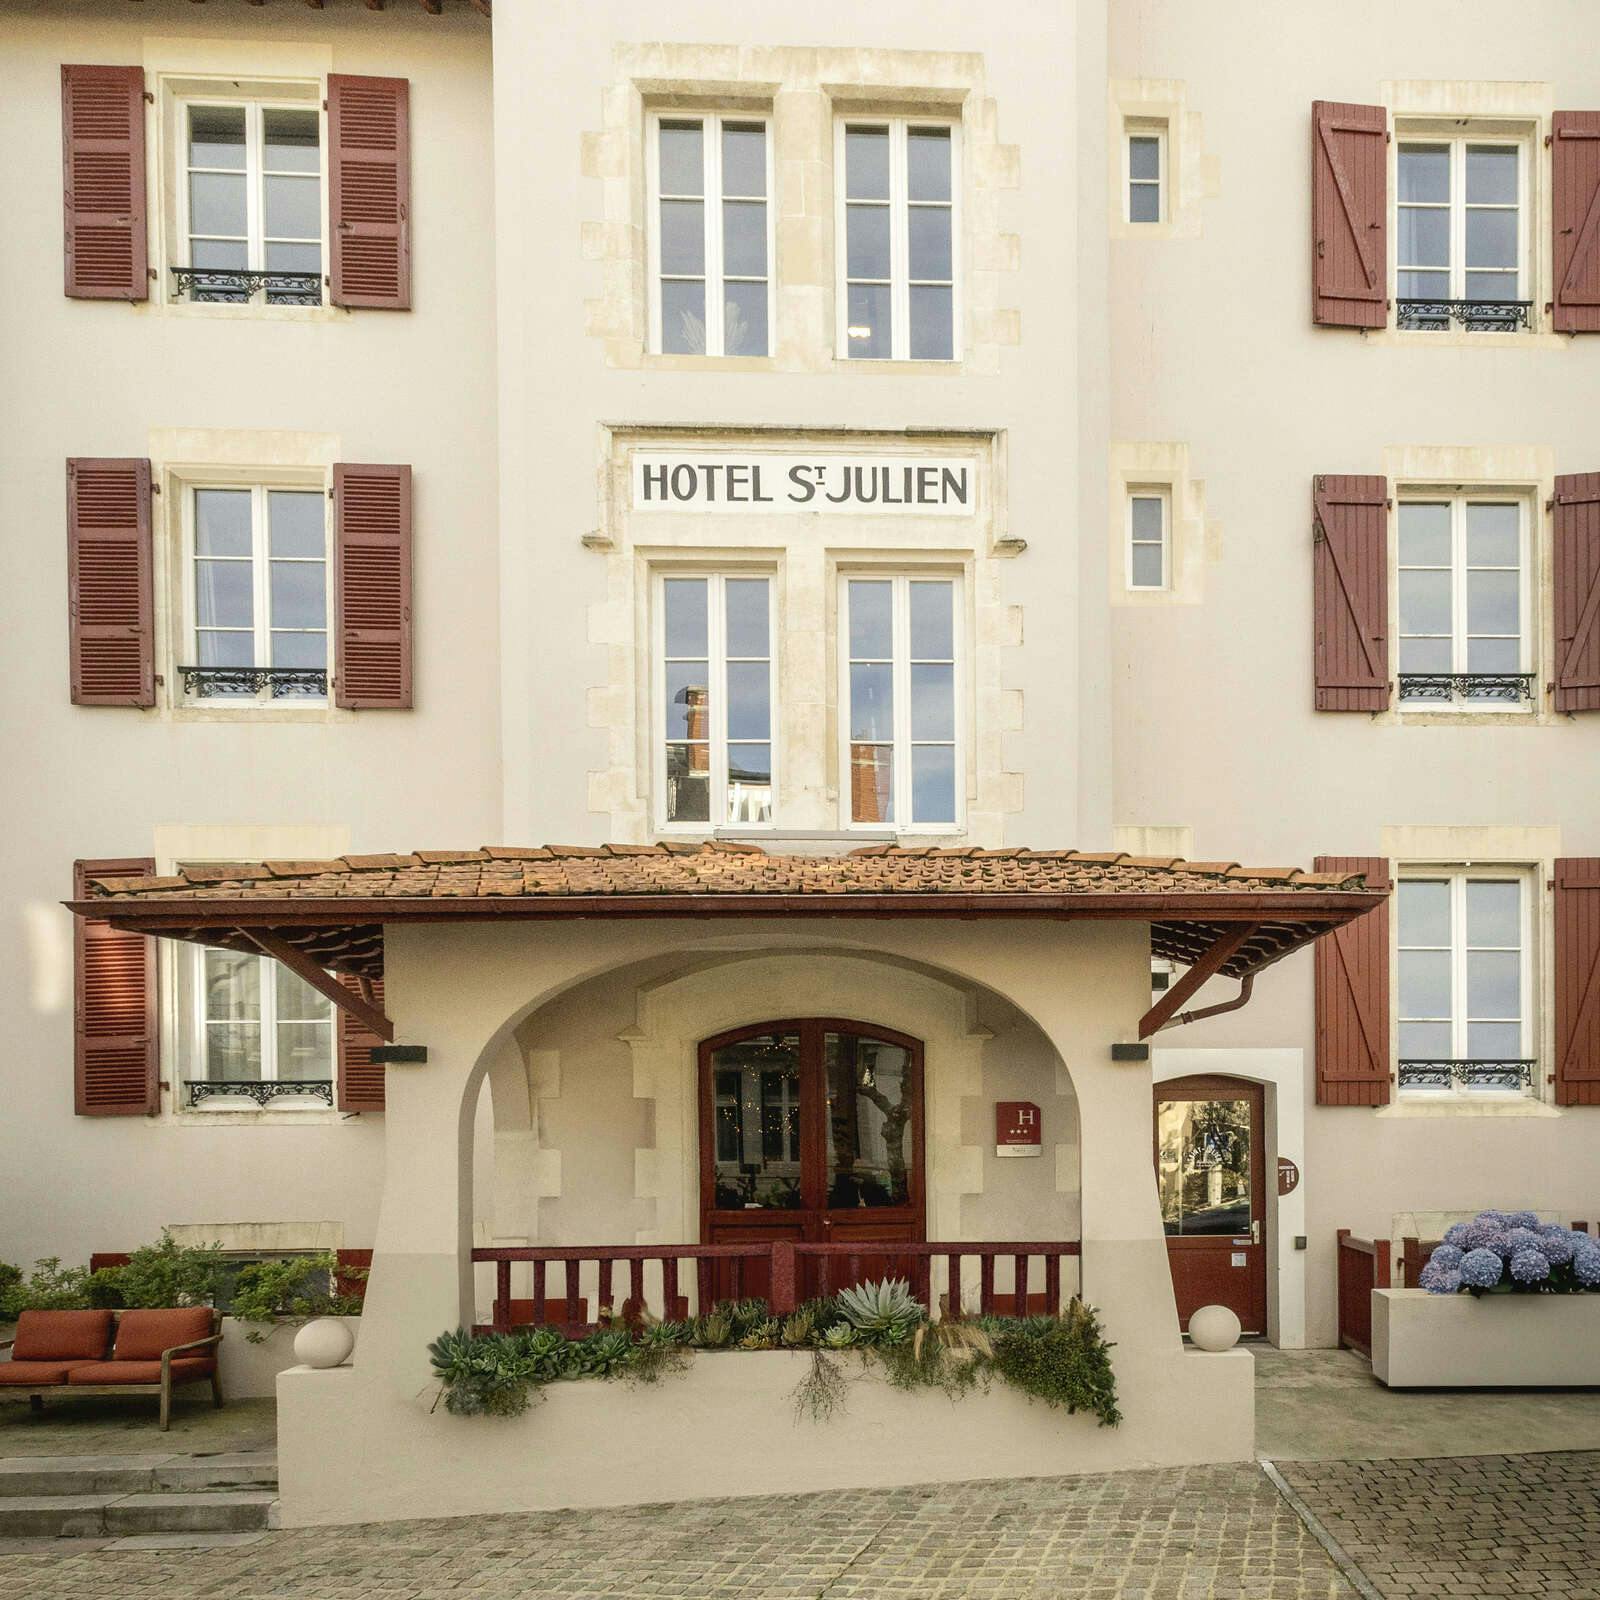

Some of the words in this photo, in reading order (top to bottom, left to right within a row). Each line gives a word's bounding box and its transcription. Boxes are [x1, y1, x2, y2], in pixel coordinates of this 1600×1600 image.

[642, 463, 774, 502] HOTEL
[825, 466, 968, 504] JULIEN
[1018, 1109, 1034, 1125] H
